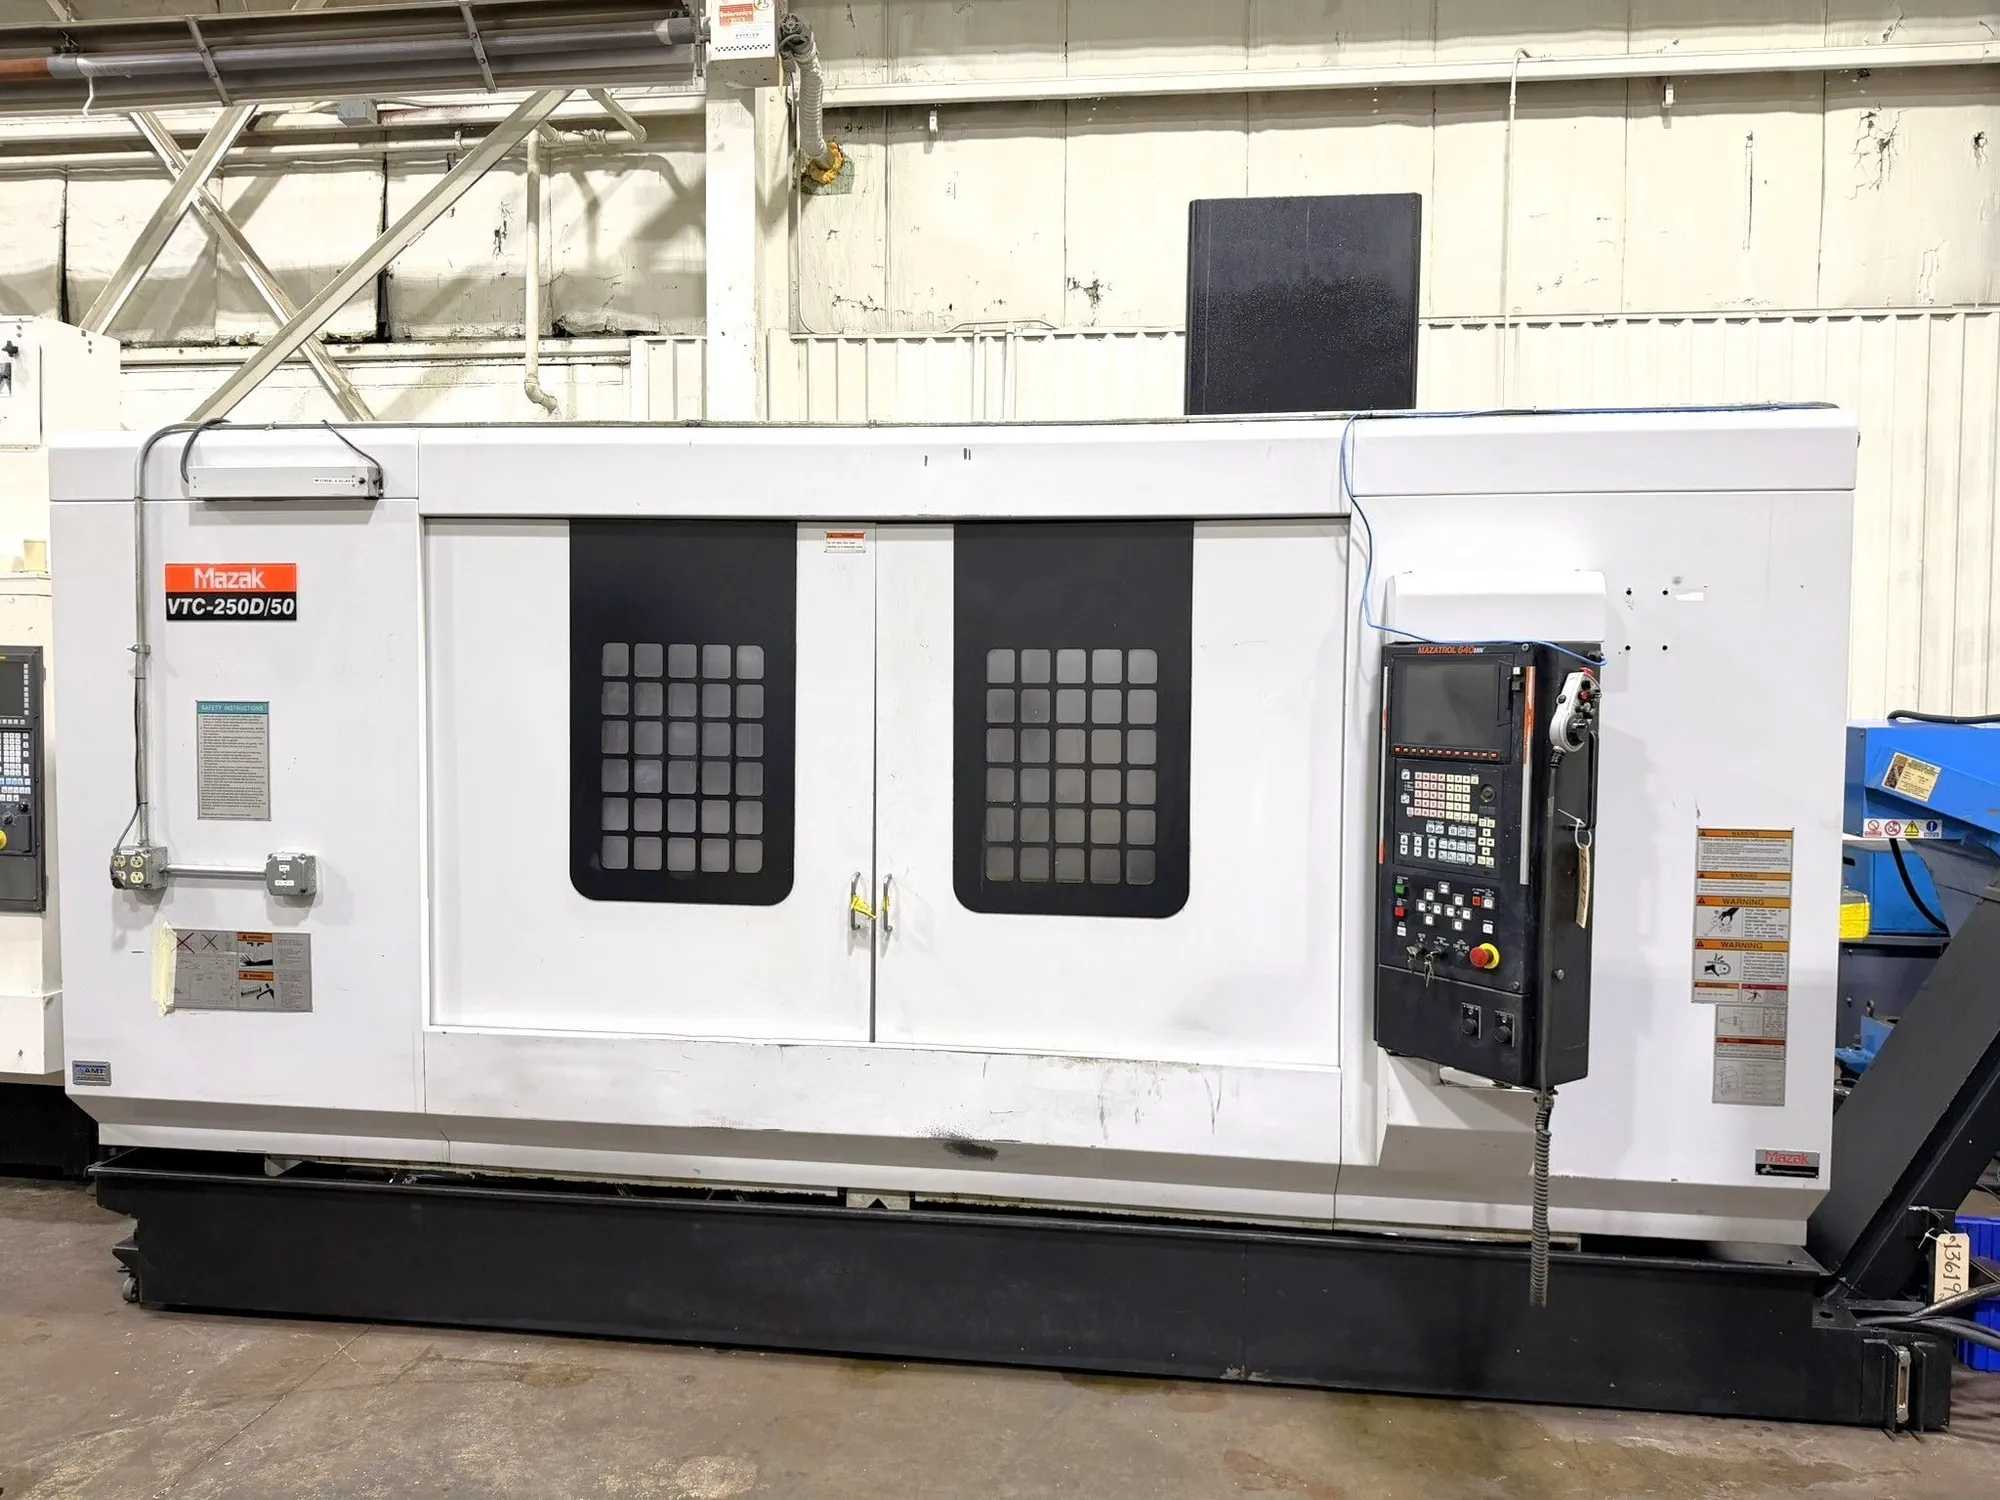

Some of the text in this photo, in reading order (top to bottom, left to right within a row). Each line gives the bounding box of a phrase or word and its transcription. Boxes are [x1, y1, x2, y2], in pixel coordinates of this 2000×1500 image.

[194, 567, 266, 589] Mazak
[167, 598, 295, 616] VTC-250D/50
[1418, 645, 1456, 654] MAZATROL
[1721, 897, 1765, 906] WARNING
[1720, 941, 1764, 949] WARNING
[1765, 1151, 1809, 1165] Mazak
